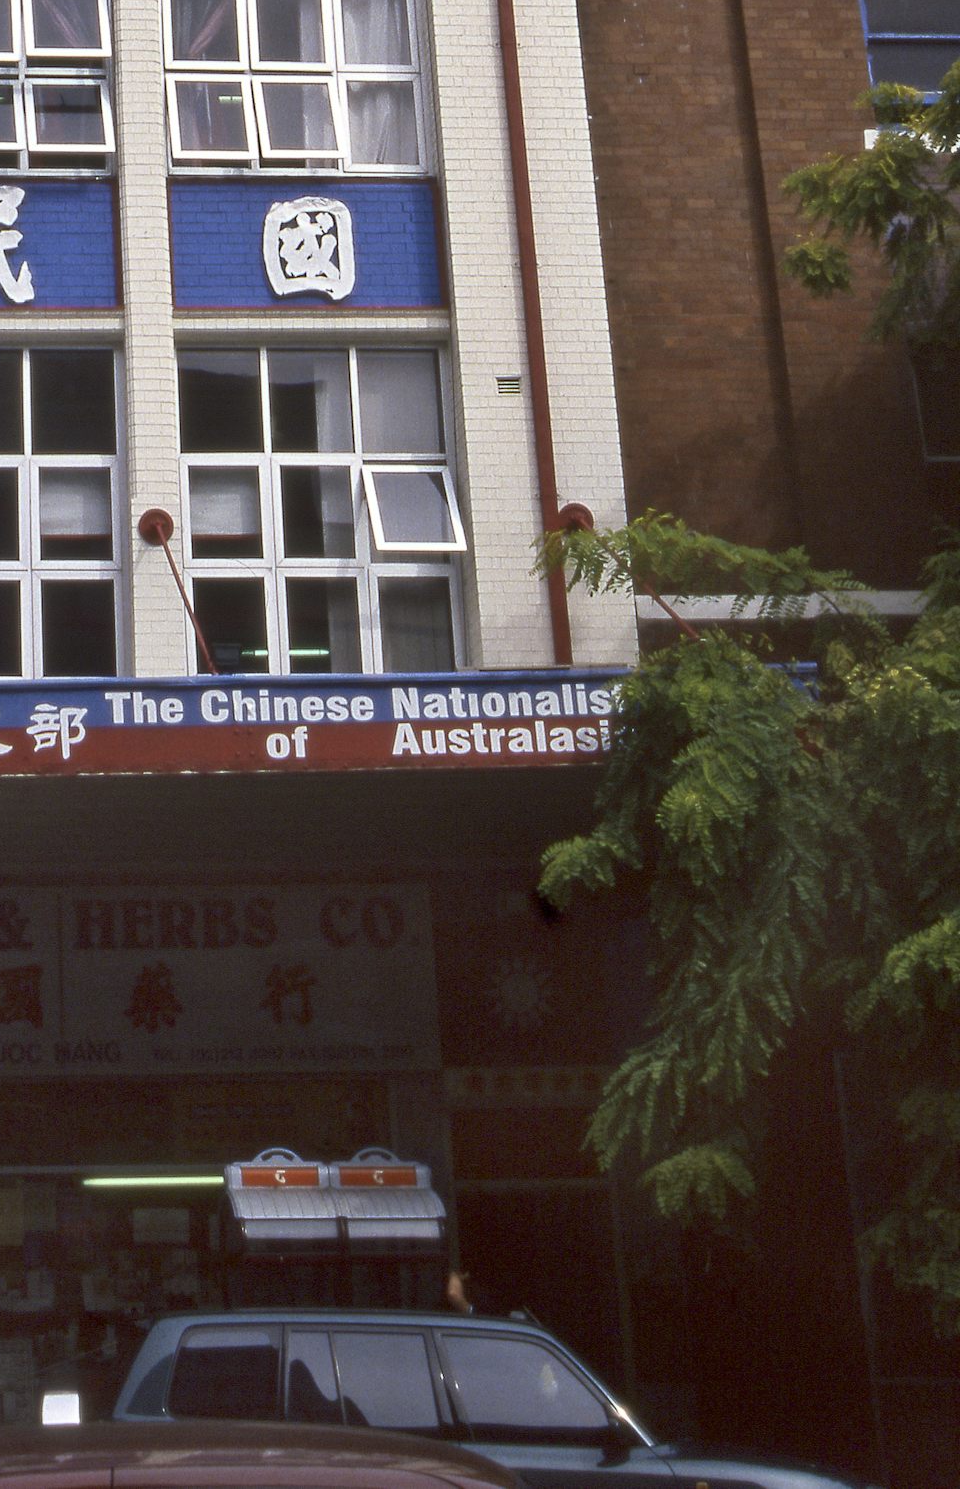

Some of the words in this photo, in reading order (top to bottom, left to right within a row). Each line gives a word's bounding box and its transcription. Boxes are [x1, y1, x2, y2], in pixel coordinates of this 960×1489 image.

[104, 691, 184, 724] The
[200, 688, 375, 723] Chinese
[266, 725, 309, 759] of
[392, 719, 616, 756] Australasi
[73, 897, 278, 951] HERBS
